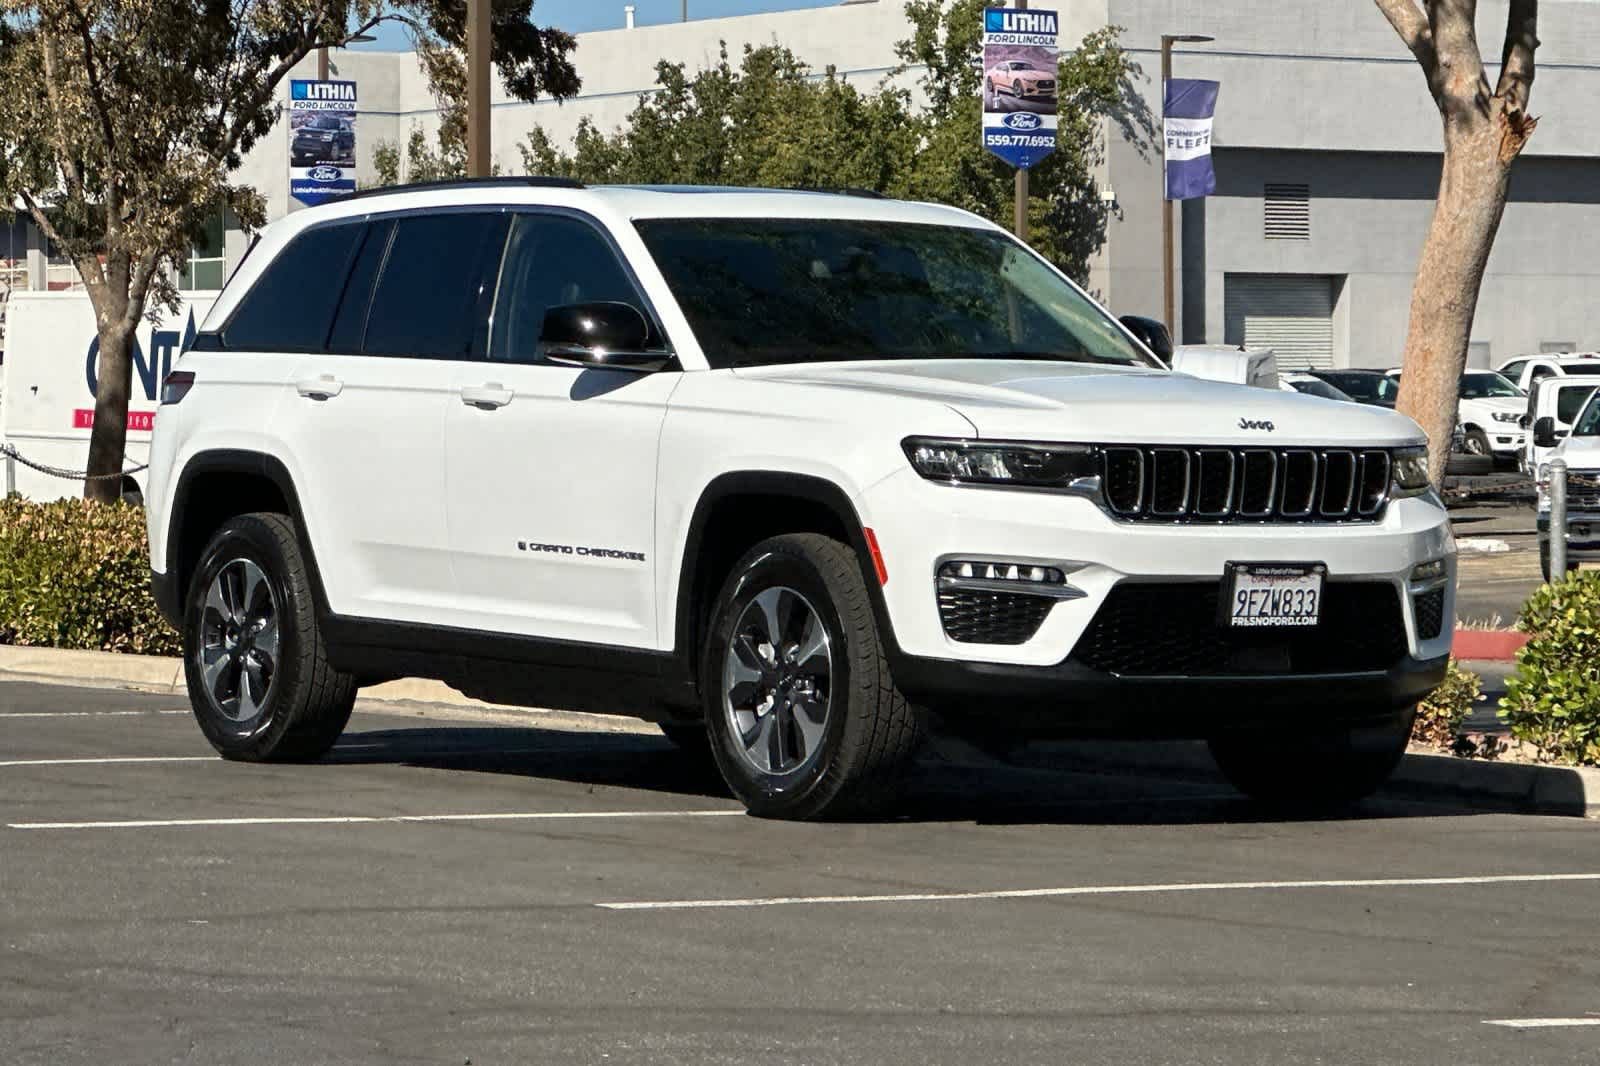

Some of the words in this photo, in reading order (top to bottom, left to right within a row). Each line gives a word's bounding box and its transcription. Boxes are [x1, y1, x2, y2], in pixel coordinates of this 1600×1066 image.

[1003, 13, 1056, 33] LITHIA
[987, 34, 1015, 43] FORD
[1017, 35, 1056, 45] LINCOLN
[307, 83, 355, 99] LITHIA
[294, 101, 318, 109] FORD
[319, 102, 355, 110] LINCOLN
[1009, 113, 1038, 129] Ford
[987, 134, 1056, 147] 559.777.6952
[1167, 134, 1209, 148] FLEET
[312, 167, 338, 180] Ford
[1238, 417, 1275, 432] Jeep
[529, 543, 573, 554] GRAND
[576, 547, 645, 561] CHEROKEE
